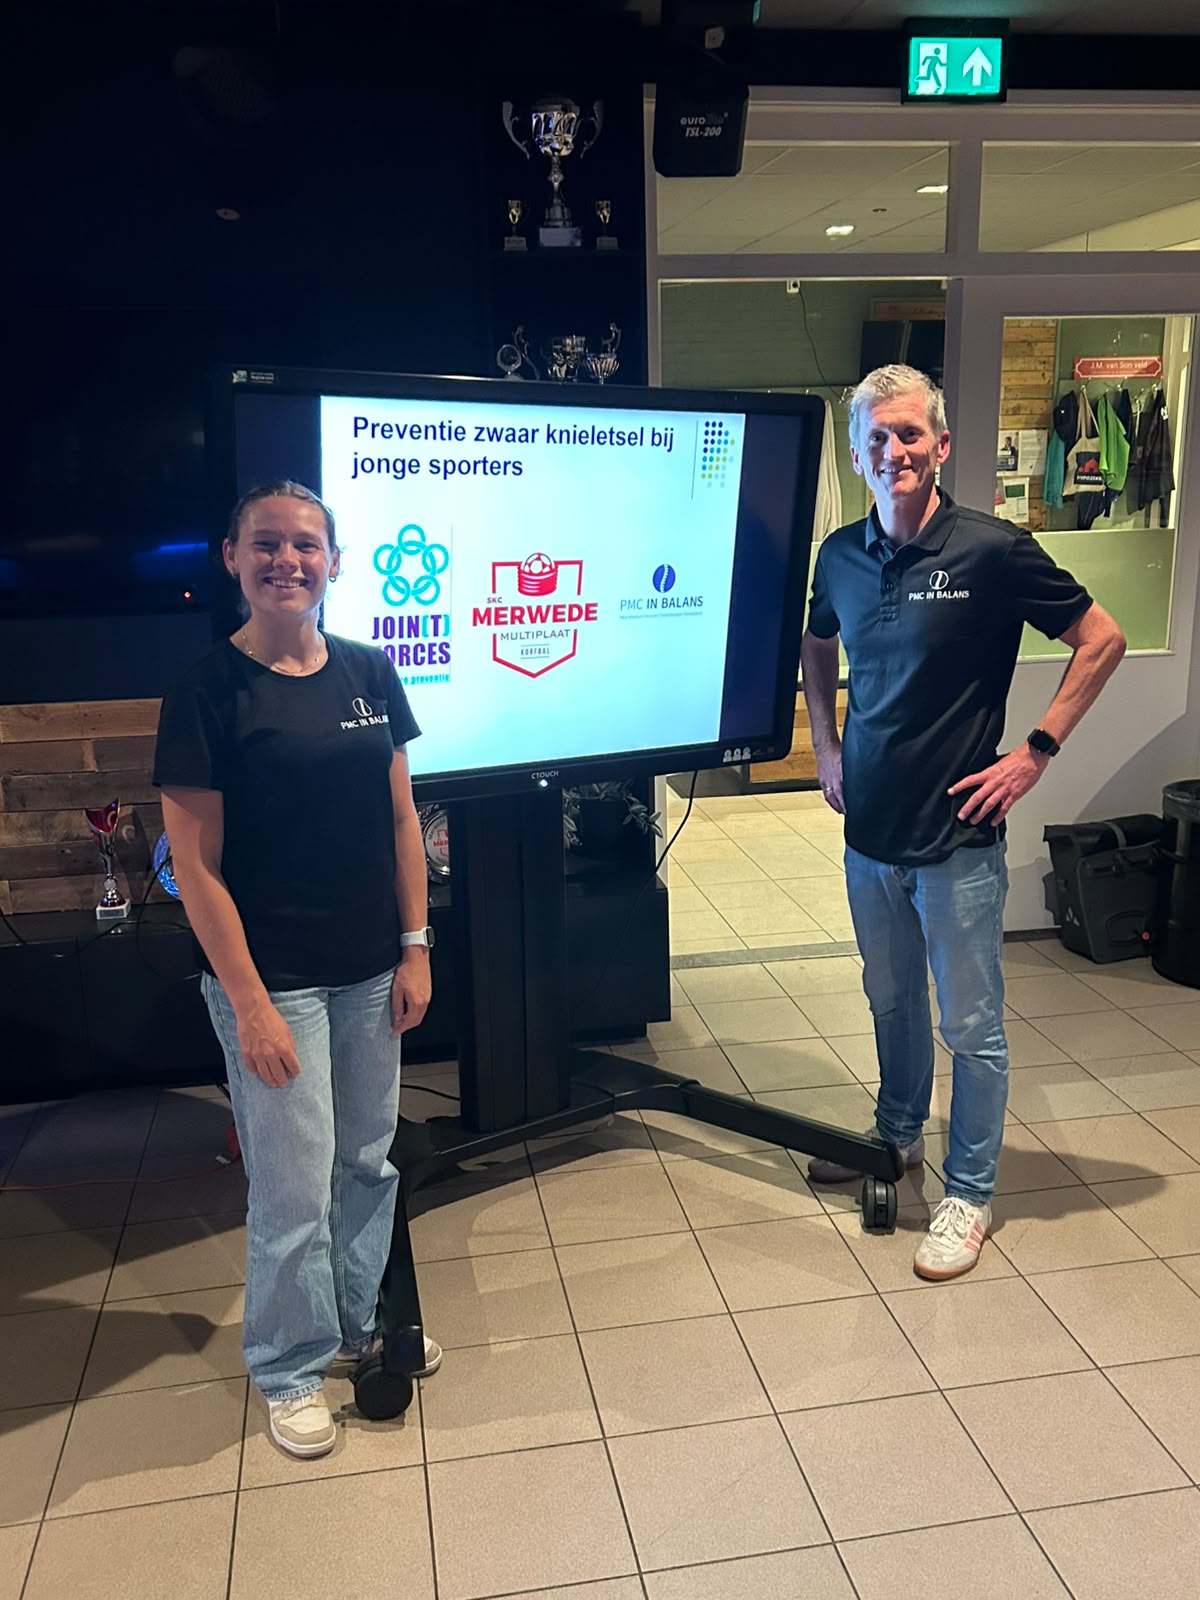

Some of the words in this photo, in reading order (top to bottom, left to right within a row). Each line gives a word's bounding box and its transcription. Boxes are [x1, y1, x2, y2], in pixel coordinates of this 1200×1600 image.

[685, 126, 722, 137] TSL-200
[1105, 361, 1118, 369] van
[353, 416, 466, 442] Preventie
[473, 426, 539, 443] zwaar
[546, 423, 644, 446] knieletsel
[651, 427, 674, 453] bij
[351, 451, 420, 480] jonge
[429, 456, 523, 480] sporters
[487, 596, 502, 604] SKC
[908, 591, 925, 601] PMC
[926, 591, 935, 600] IN
[936, 590, 970, 599] BALANS
[620, 599, 643, 611] PMC
[646, 598, 658, 609] IN
[661, 595, 704, 609] BALANS
[472, 602, 598, 627] MERWEDE
[372, 614, 450, 640] JOIN(T)
[500, 628, 571, 641] MULTIPLAAT
[380, 641, 451, 667] ORCES
[520, 647, 550, 656] KORFBAL
[340, 719, 359, 730] PMC
[359, 717, 369, 727] IN
[531, 770, 559, 779] CTOUCH
